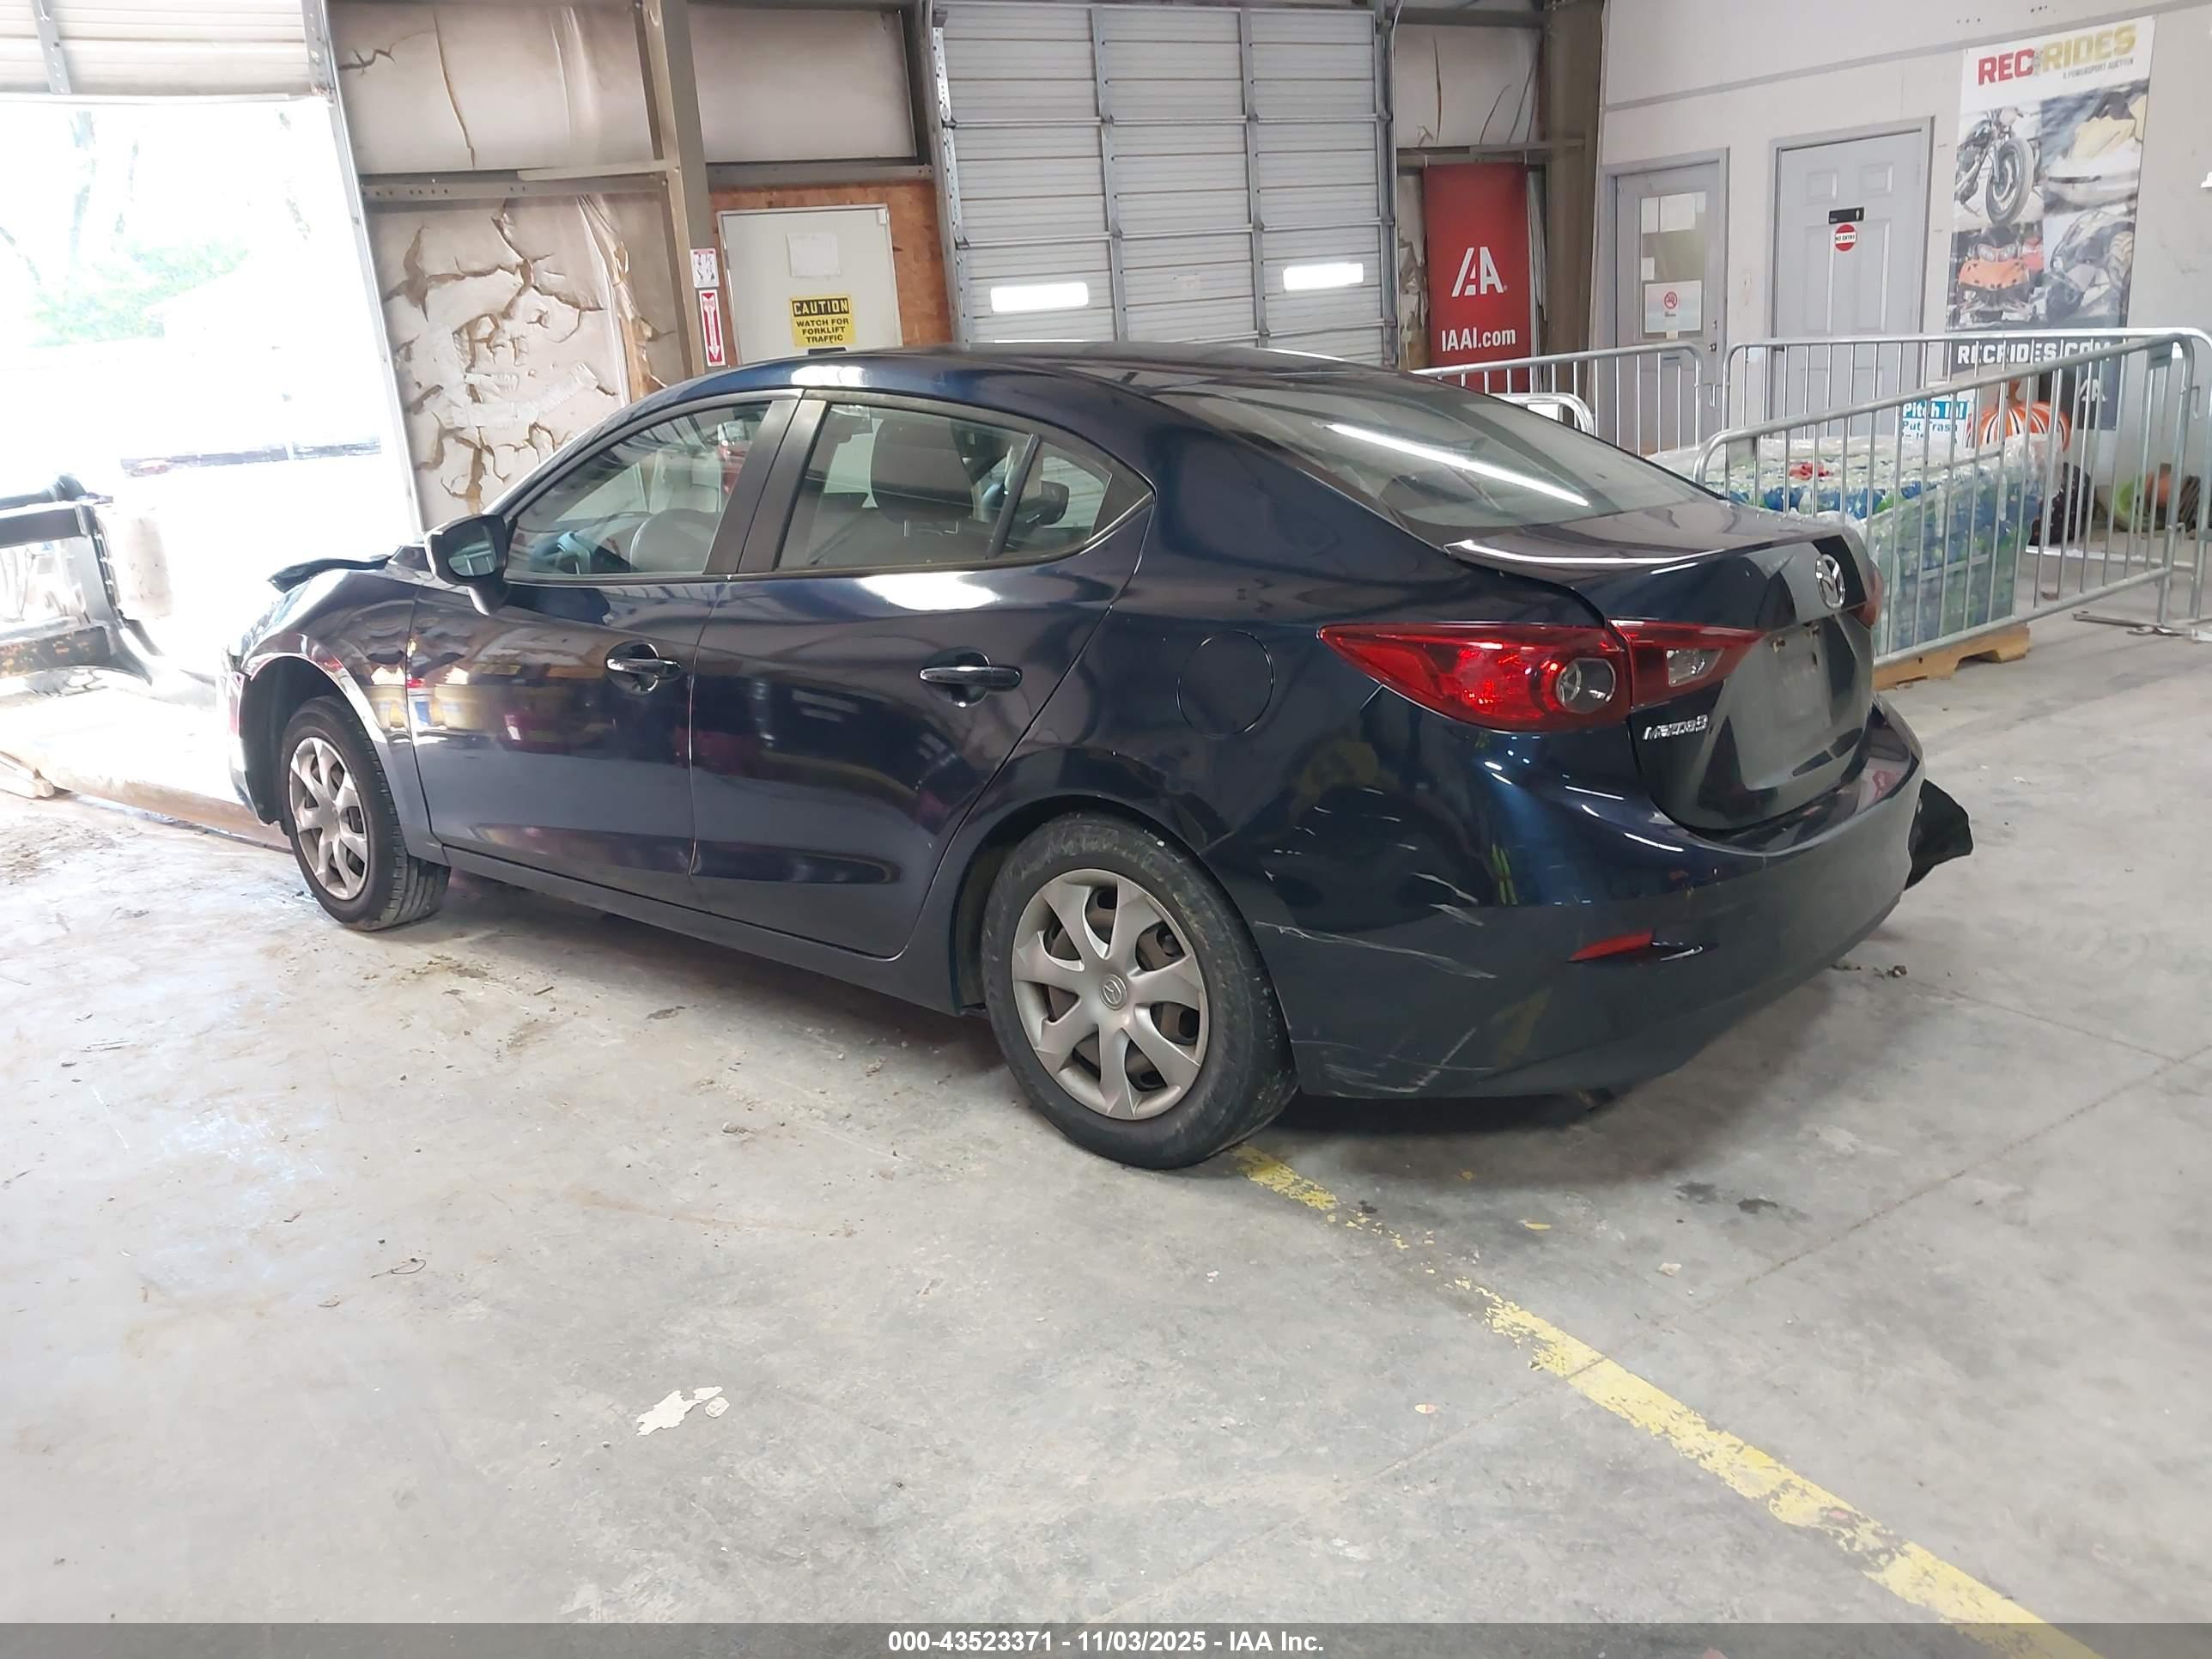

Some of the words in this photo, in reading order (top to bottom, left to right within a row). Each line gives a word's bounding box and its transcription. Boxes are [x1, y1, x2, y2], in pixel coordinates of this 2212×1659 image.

[793, 300, 848, 315] CAUTION
[802, 326, 846, 336] FORKLIFT
[805, 334, 843, 344] TRAFFIC
[1442, 327, 1516, 352] IAAI.com
[1958, 342, 2112, 364] RECRIDESCO
[1903, 399, 1941, 418] Pith
[1929, 420, 1958, 432] ras
